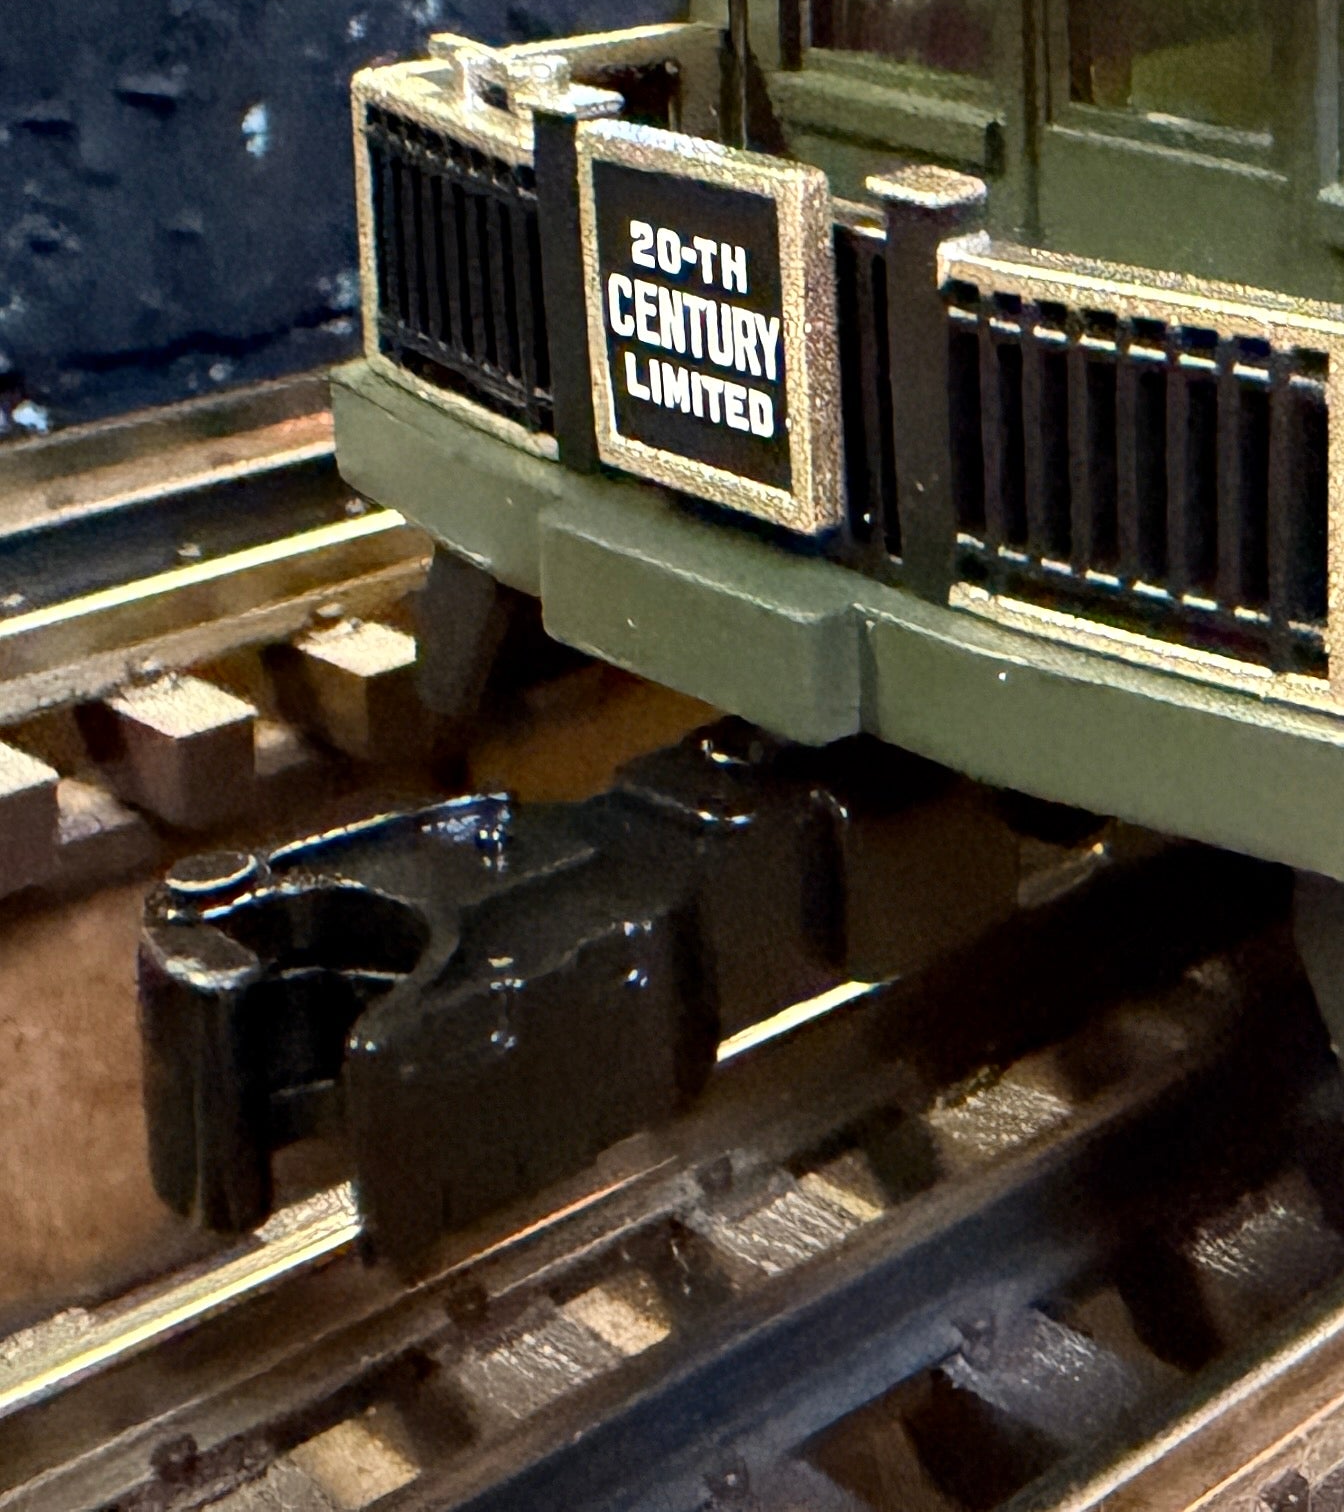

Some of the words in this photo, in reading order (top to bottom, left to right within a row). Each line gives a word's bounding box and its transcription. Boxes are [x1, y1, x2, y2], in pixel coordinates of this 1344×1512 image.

[629, 219, 748, 294] 20-TH
[607, 272, 781, 381] CENTURY
[623, 350, 775, 439] LIMITED
